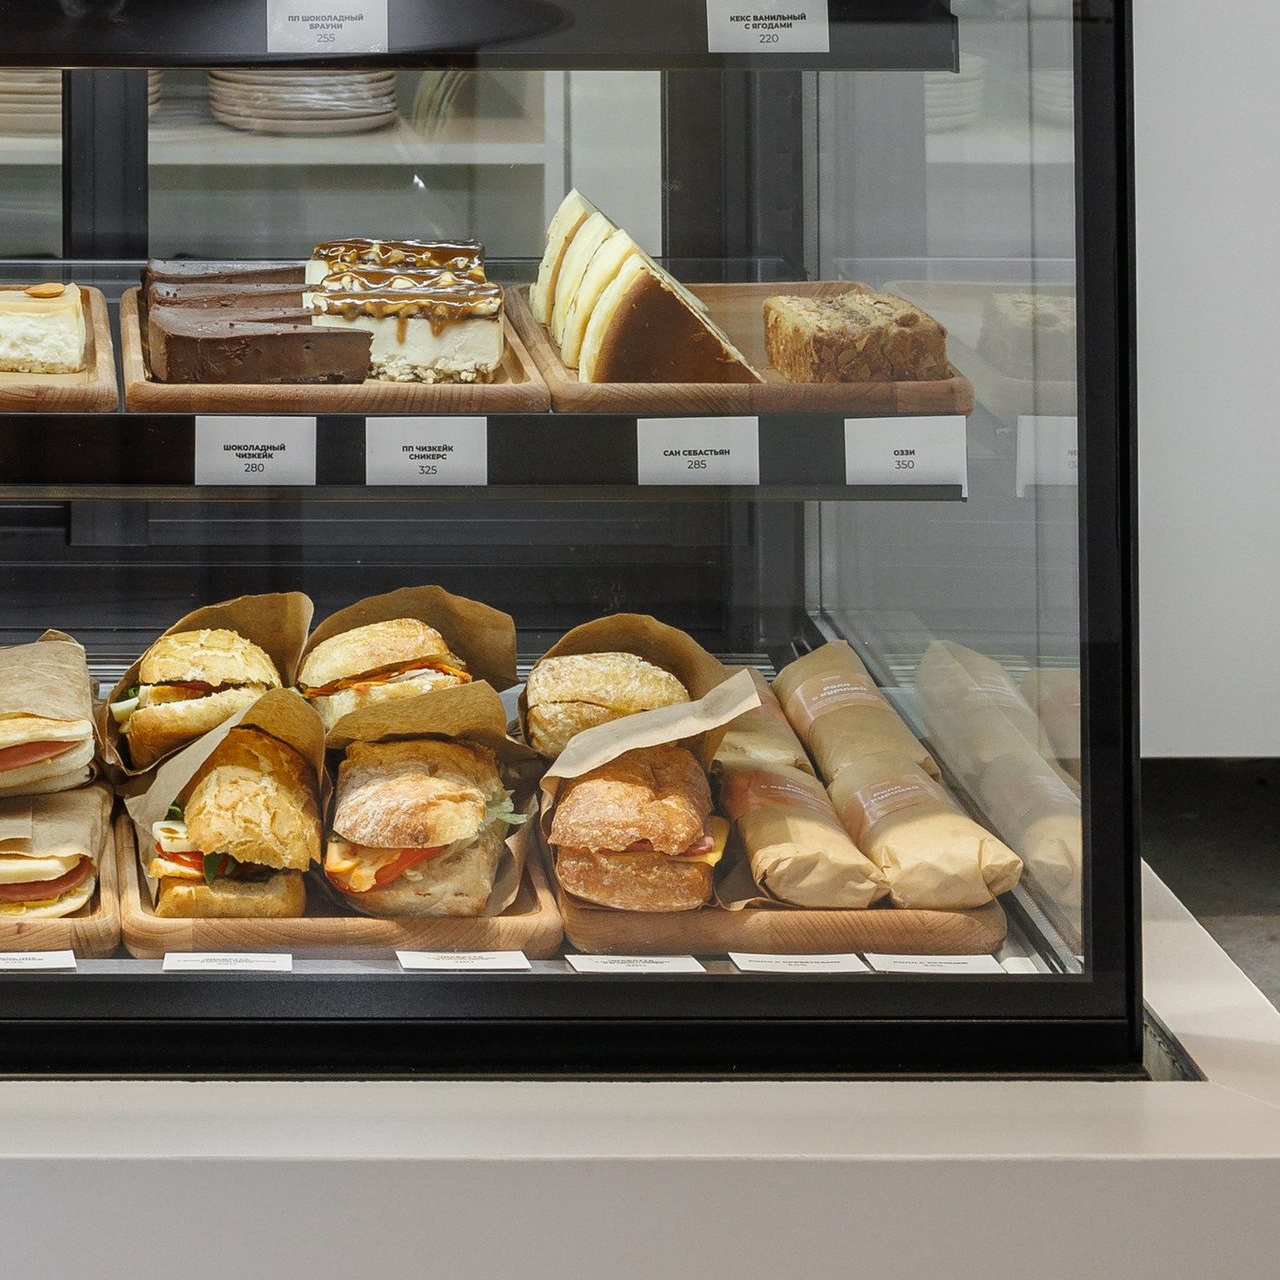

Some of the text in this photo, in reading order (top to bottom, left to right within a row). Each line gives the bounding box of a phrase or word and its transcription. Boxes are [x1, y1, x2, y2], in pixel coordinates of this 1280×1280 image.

[301, 13, 364, 23] ШОКОЛАДНЫЙ
[752, 12, 807, 22] ВАНИЛЬНЫЙ
[309, 22, 343, 30] БРАУНИ
[751, 21, 793, 30] ЯГОДАМИ
[316, 33, 336, 43] 255
[758, 33, 780, 44] 220
[223, 443, 286, 453] ШОКОЛАДНЫЙ
[401, 444, 454, 453] ПП ЧИЗКЕЙК
[662, 449, 731, 457] САН СЕБАСТЬЯН
[893, 449, 916, 457] ОЗЗИ
[235, 450, 274, 460] ЧИЗКЕЙК
[408, 452, 447, 461] СНИКЕРС
[244, 462, 265, 473] 280
[686, 459, 707, 470] 285
[894, 459, 915, 470] 350
[418, 465, 438, 475] 325
